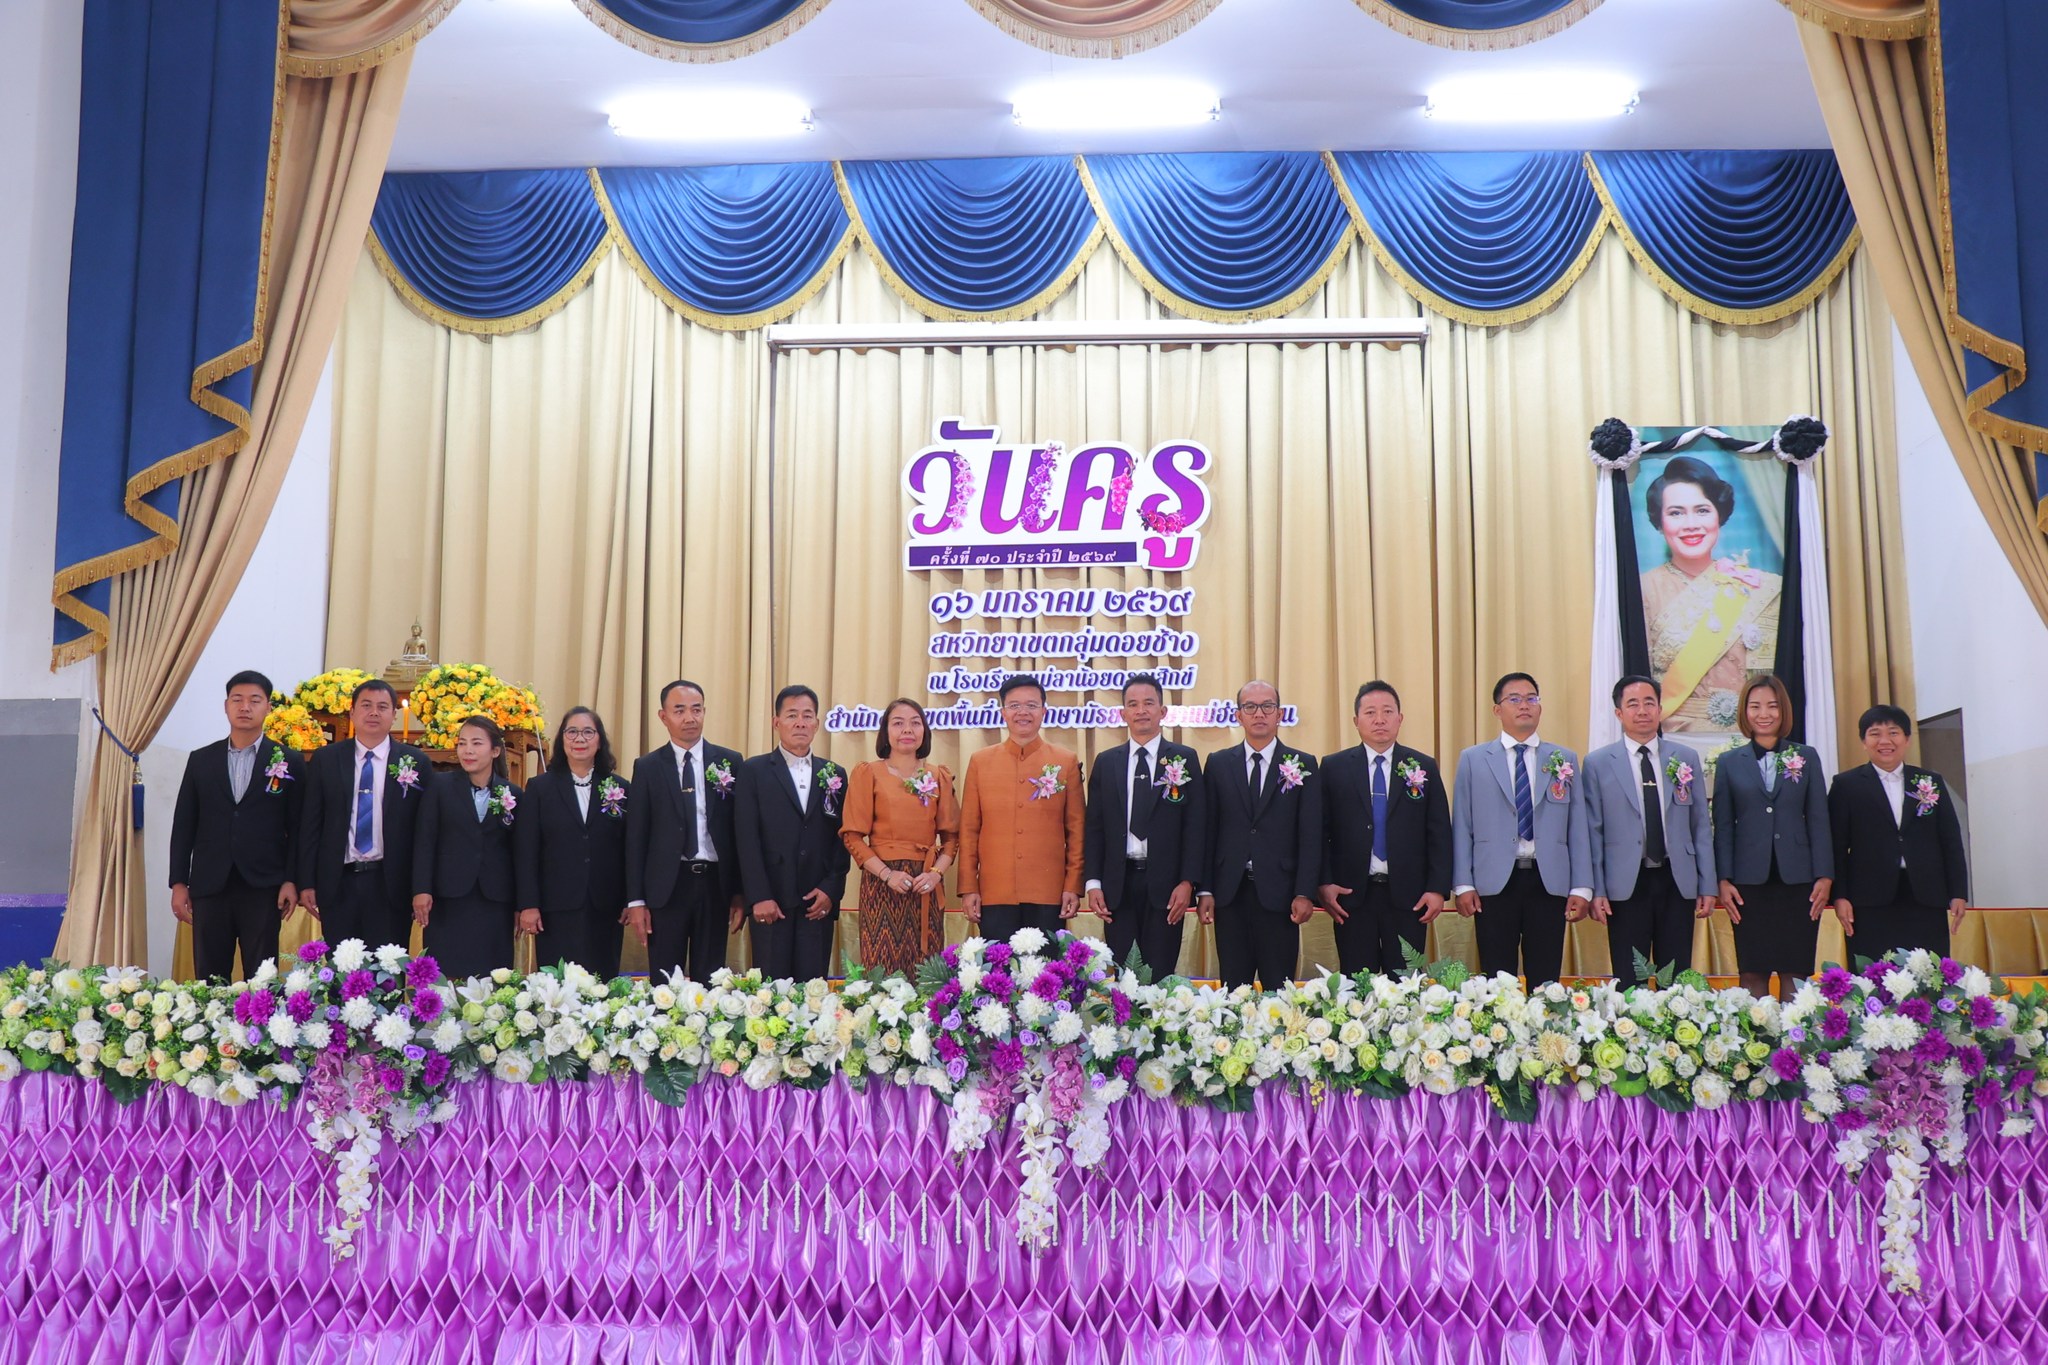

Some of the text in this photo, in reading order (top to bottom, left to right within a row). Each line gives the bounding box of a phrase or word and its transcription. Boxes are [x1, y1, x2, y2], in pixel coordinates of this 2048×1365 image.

[909, 421, 1205, 568] วันครู
[930, 546, 1117, 565] ครั้งที่ ๗๐ ประจำปี ๒๕๖๙
[931, 590, 1192, 617] ๑๖ มกราคม ๒๕๖๙
[931, 628, 1194, 660] สหวิทยาเขตกลุ่มดอยช้าง
[929, 675, 947, 690] ณ
